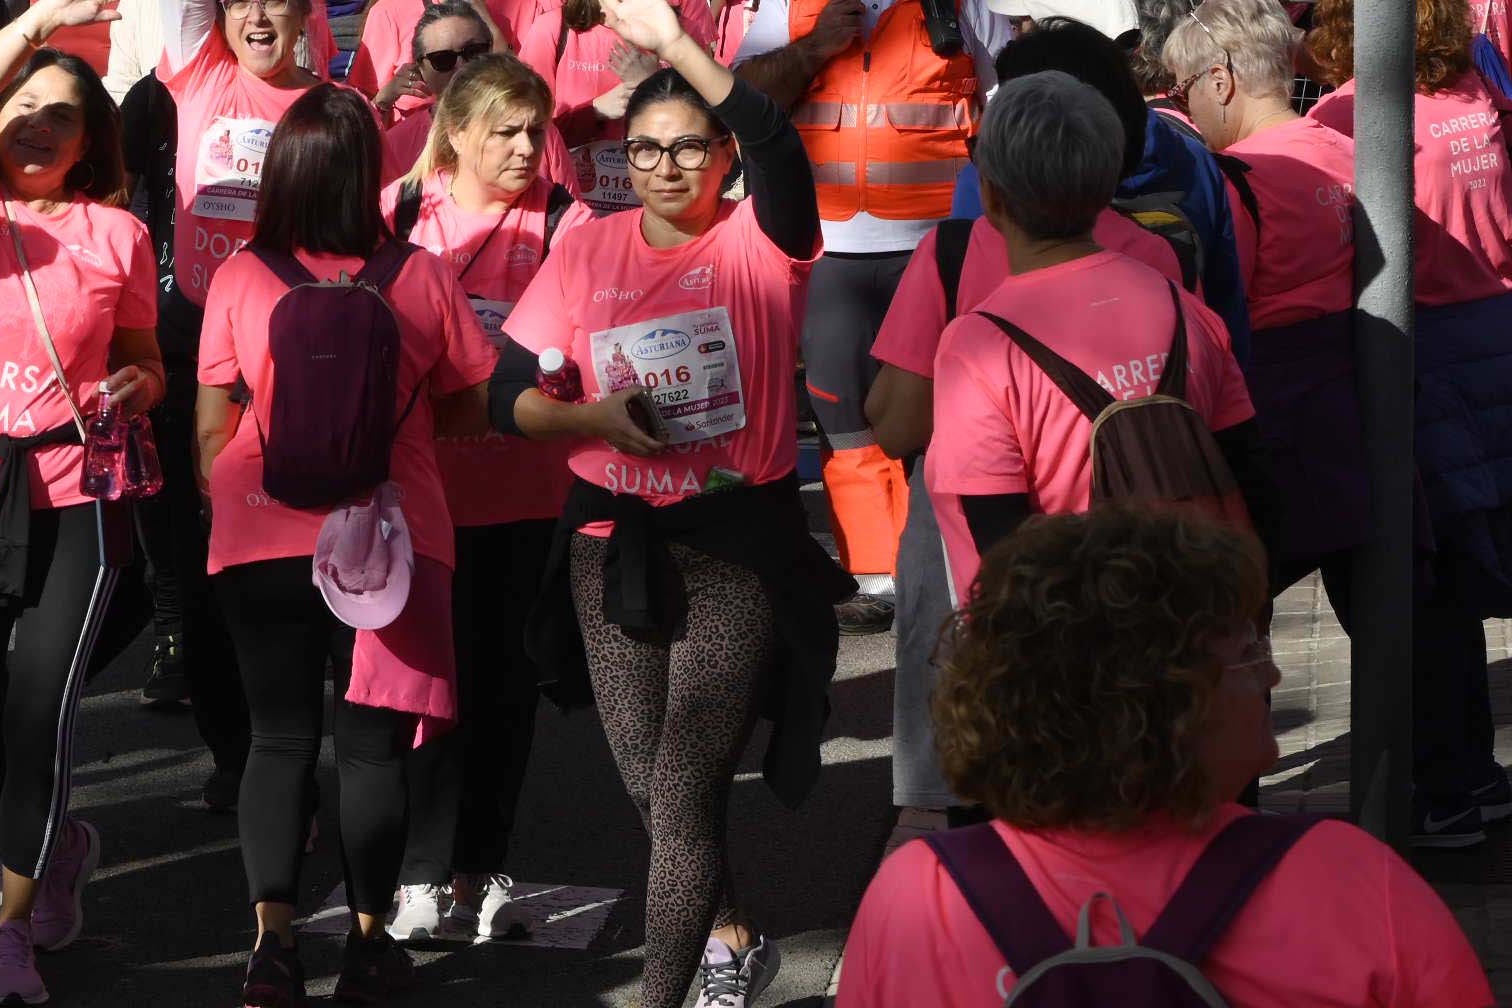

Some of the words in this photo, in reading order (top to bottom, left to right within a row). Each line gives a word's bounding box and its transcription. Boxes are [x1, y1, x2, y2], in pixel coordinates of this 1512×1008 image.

[1450, 137, 1470, 156] DE
[1473, 133, 1491, 150] LA
[1450, 152, 1498, 178] MUJER
[599, 174, 633, 190] 016
[602, 192, 628, 202] 11497
[203, 200, 236, 213] OYSHO
[637, 338, 687, 355] ASTURIANA
[644, 365, 692, 389] 016
[654, 389, 689, 405] 27622
[604, 462, 702, 494] SUMA
